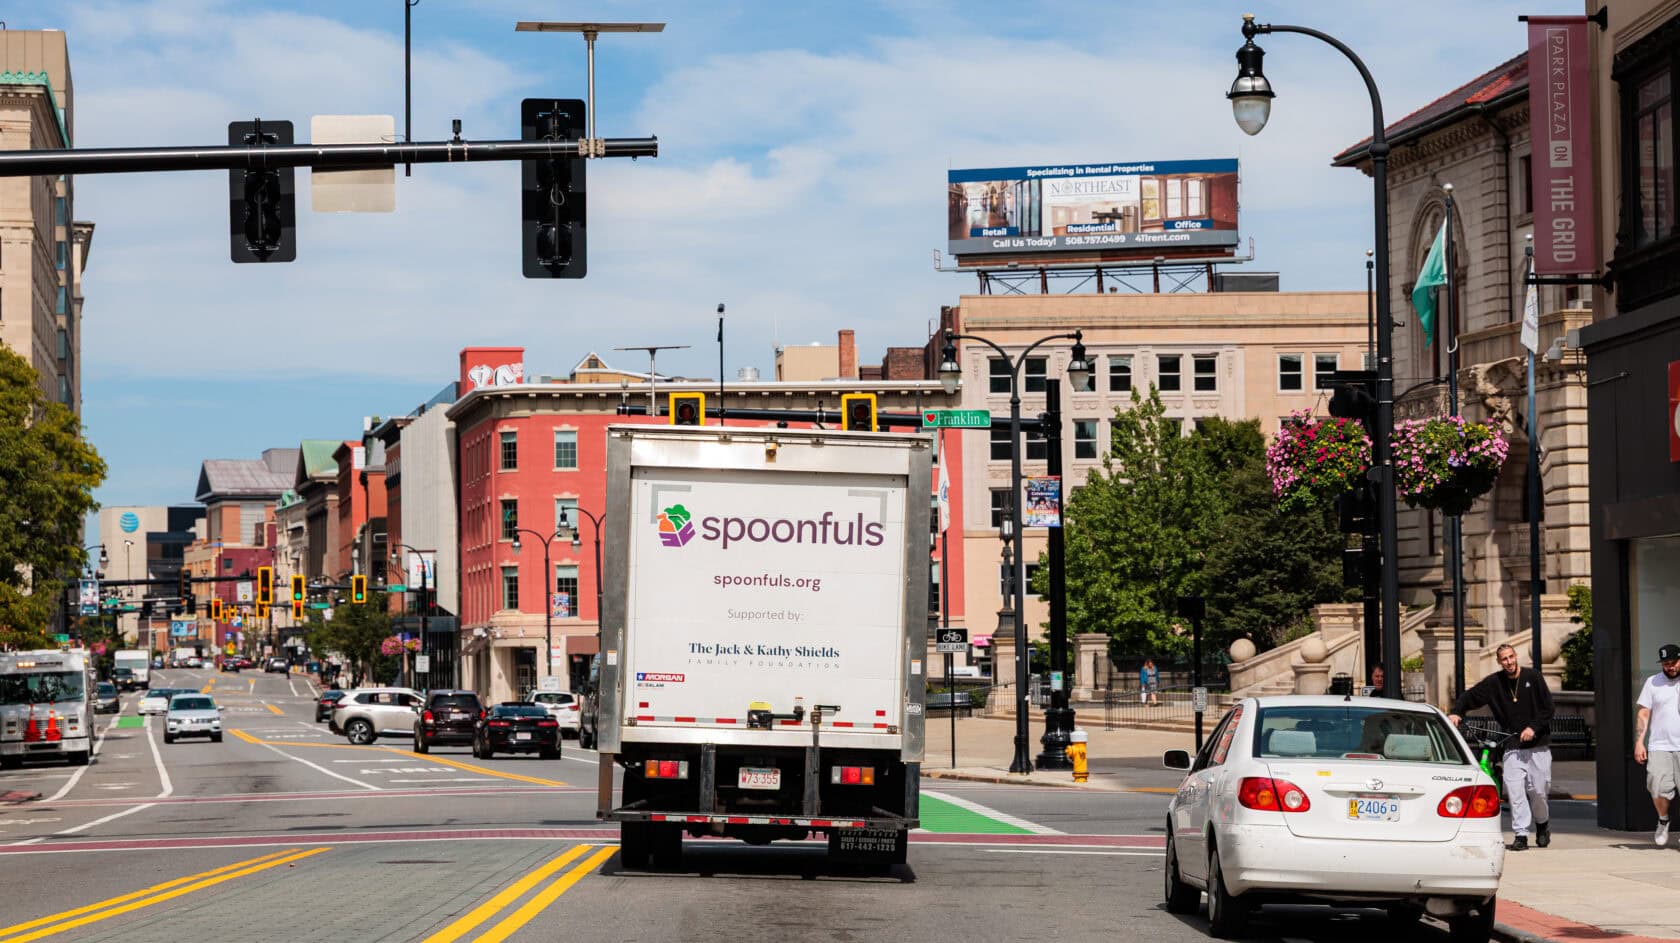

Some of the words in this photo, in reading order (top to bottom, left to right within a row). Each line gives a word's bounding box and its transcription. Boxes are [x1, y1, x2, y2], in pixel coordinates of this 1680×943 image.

[1551, 36, 1565, 75] PARK
[1553, 82, 1566, 134] PLAZA
[1554, 146, 1567, 161] ON
[1027, 167, 1074, 177] Specializing
[1076, 167, 1083, 175] in
[1085, 165, 1111, 174] Rental
[1113, 164, 1154, 173] Properties
[1050, 179, 1131, 193] NORTHEAST
[1551, 175, 1574, 211] THE
[1067, 223, 1115, 233] Residential
[1174, 220, 1202, 229] Office
[982, 228, 1007, 236] Retail
[993, 240, 1010, 248] Call
[1012, 239, 1024, 247] Us
[1026, 238, 1056, 247] Today!
[1552, 218, 1576, 262] GRID
[937, 411, 980, 425] Franklin
[702, 511, 884, 549] spoonfuls
[714, 574, 821, 592] spoonfuls.org
[727, 609, 784, 621] Supported
[688, 642, 713, 654] The
[715, 643, 741, 656] Jack
[743, 644, 754, 655] &
[757, 644, 792, 659] Kathy
[795, 646, 840, 658] Shields
[749, 660, 840, 669] FOUNDATION
